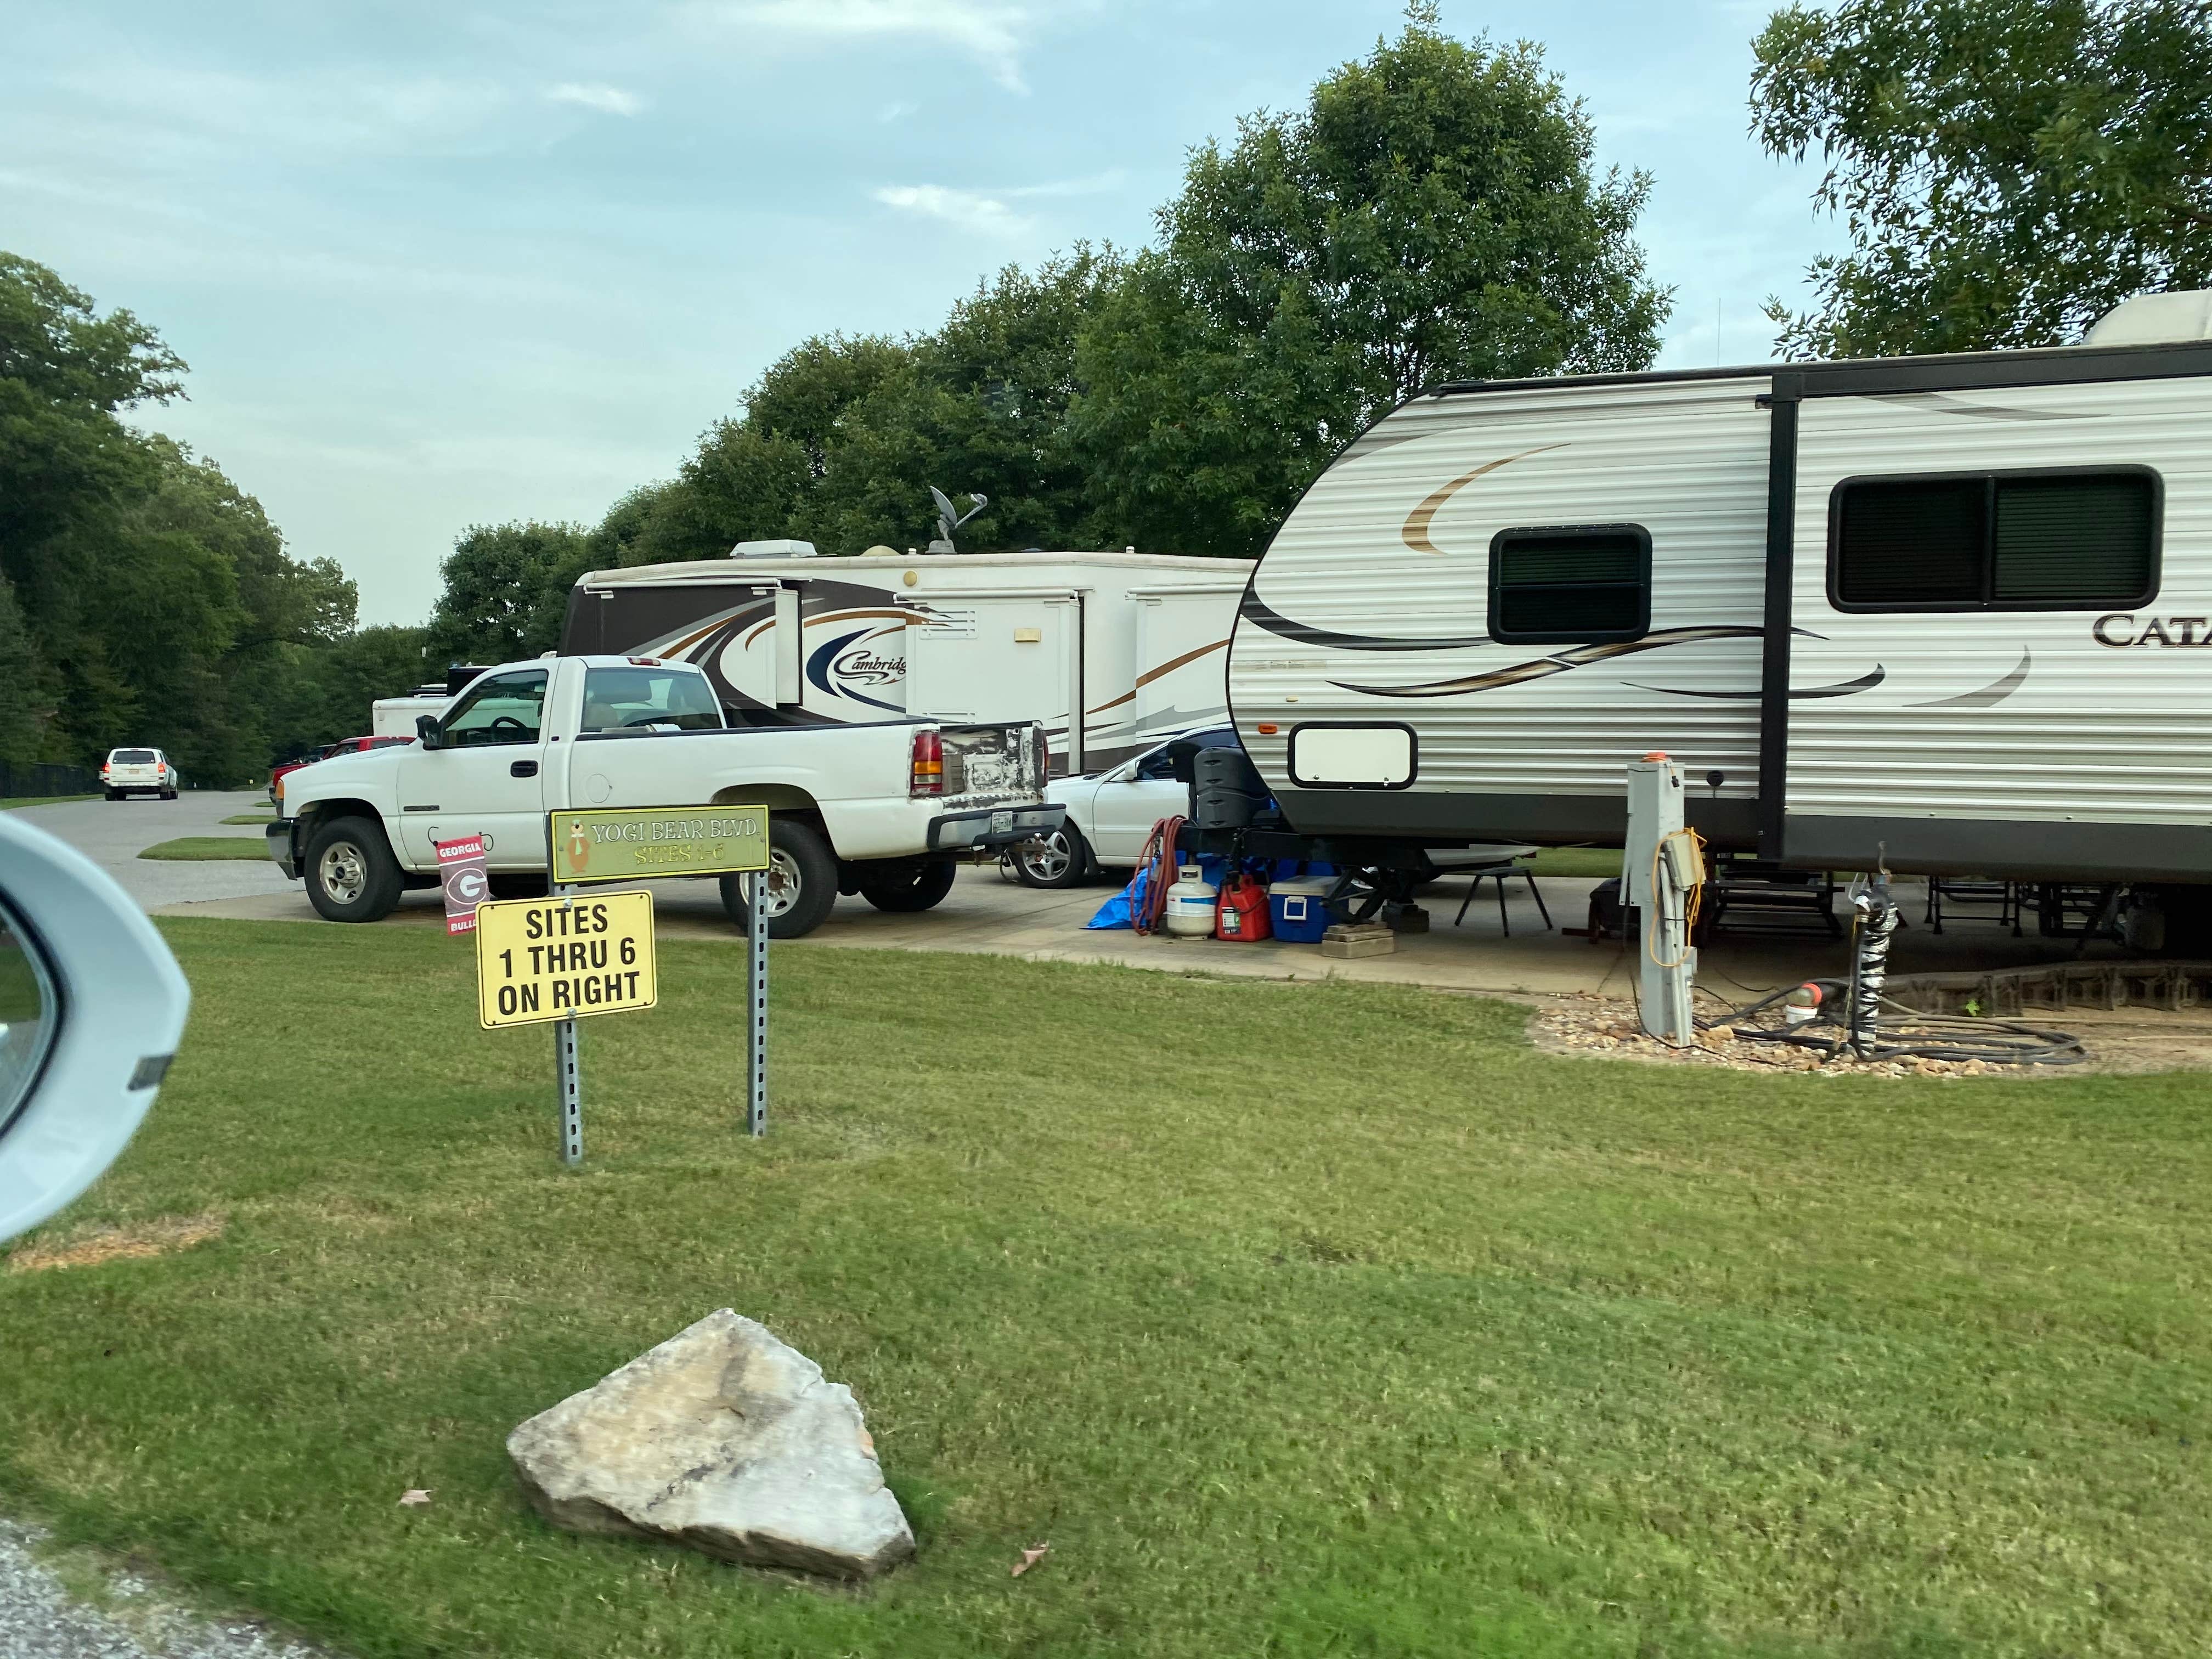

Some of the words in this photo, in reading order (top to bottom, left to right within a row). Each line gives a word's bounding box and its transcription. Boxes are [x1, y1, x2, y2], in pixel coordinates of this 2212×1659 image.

[833, 650, 906, 676] Cambridg
[591, 822, 645, 843] YOGI
[651, 819, 704, 840] BEAR
[710, 818, 760, 838] BLVD.
[439, 842, 481, 858] GEORGIA
[634, 844, 691, 865] SITES
[697, 843, 725, 861] 1-6
[459, 874, 487, 898] G
[526, 904, 608, 939] SITES
[499, 949, 512, 978] 1
[527, 939, 607, 975] THRU
[620, 937, 635, 965] 6
[498, 983, 539, 1015] ON
[552, 970, 640, 1009] RIGHT
